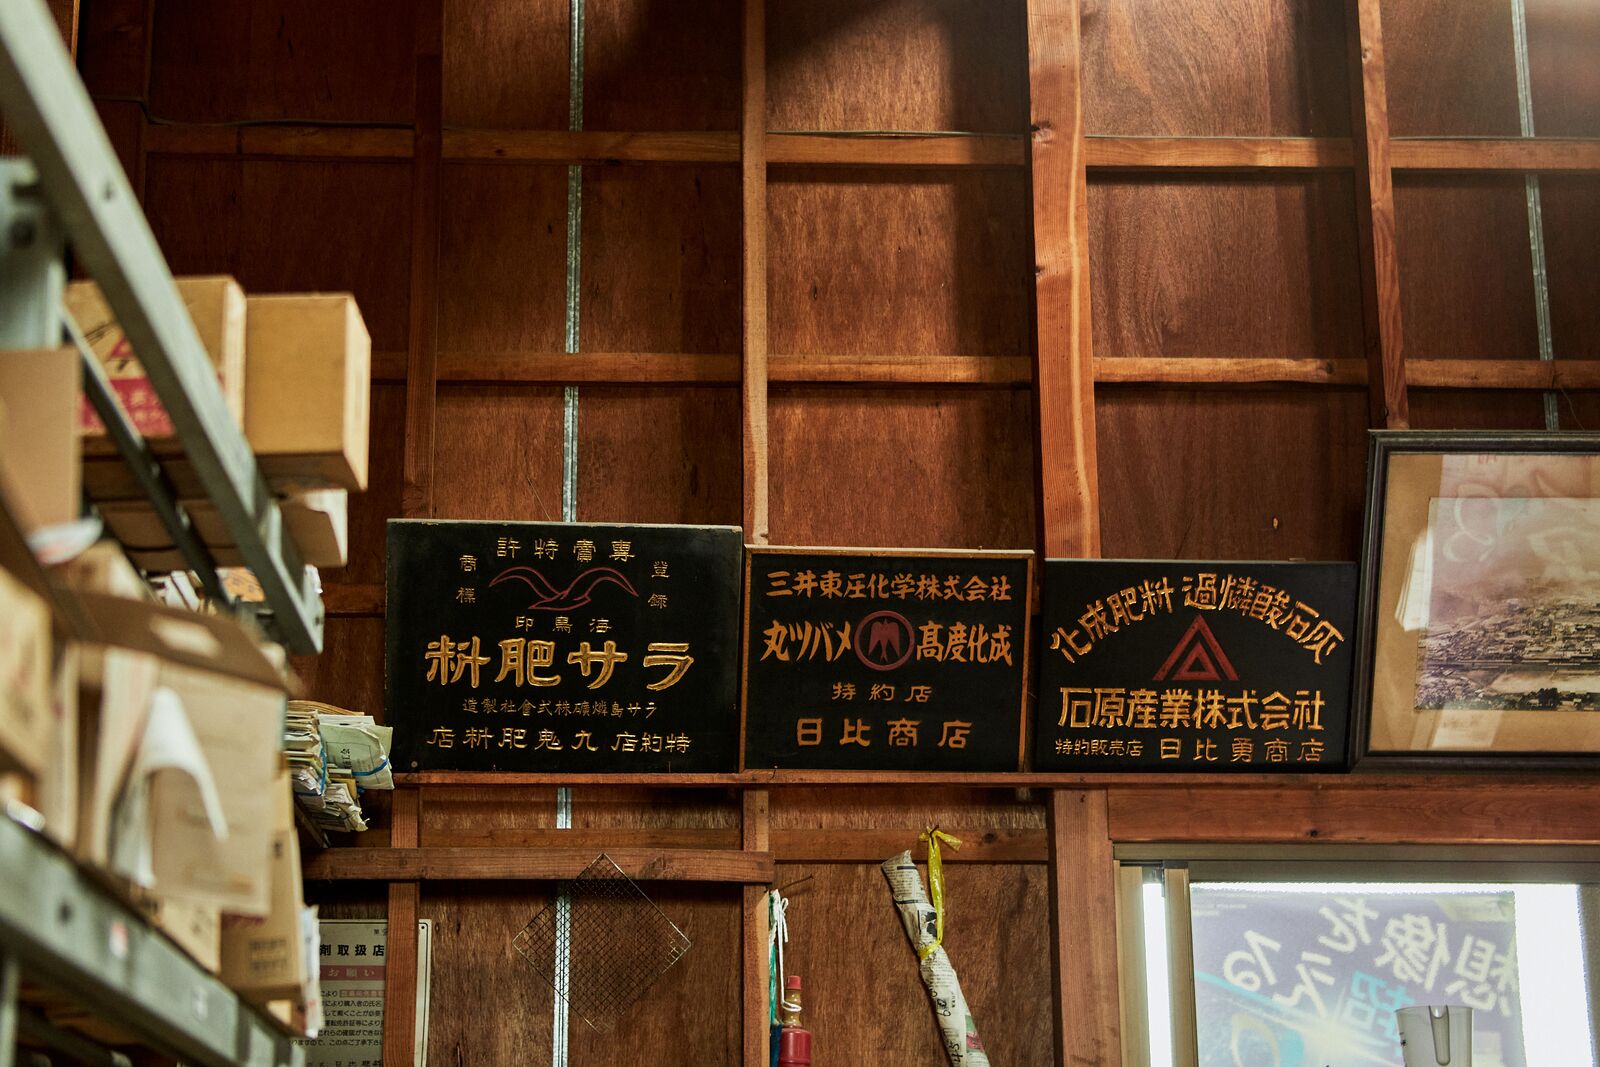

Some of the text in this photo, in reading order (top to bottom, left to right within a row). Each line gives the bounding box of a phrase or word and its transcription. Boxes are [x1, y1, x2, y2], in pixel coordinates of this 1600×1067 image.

[766, 569, 1012, 602] 三井東圧化学株式会社
[1049, 576, 1176, 664] 化成肥料
[760, 619, 852, 663] 丸ツバメ
[831, 681, 933, 704] 特約店
[1057, 687, 1326, 731] 石原産業株式会社
[796, 717, 974, 750] 日比商店
[1055, 736, 1326, 763] 特約販売店 日比勇商店
[319, 967, 376, 978] お願い
